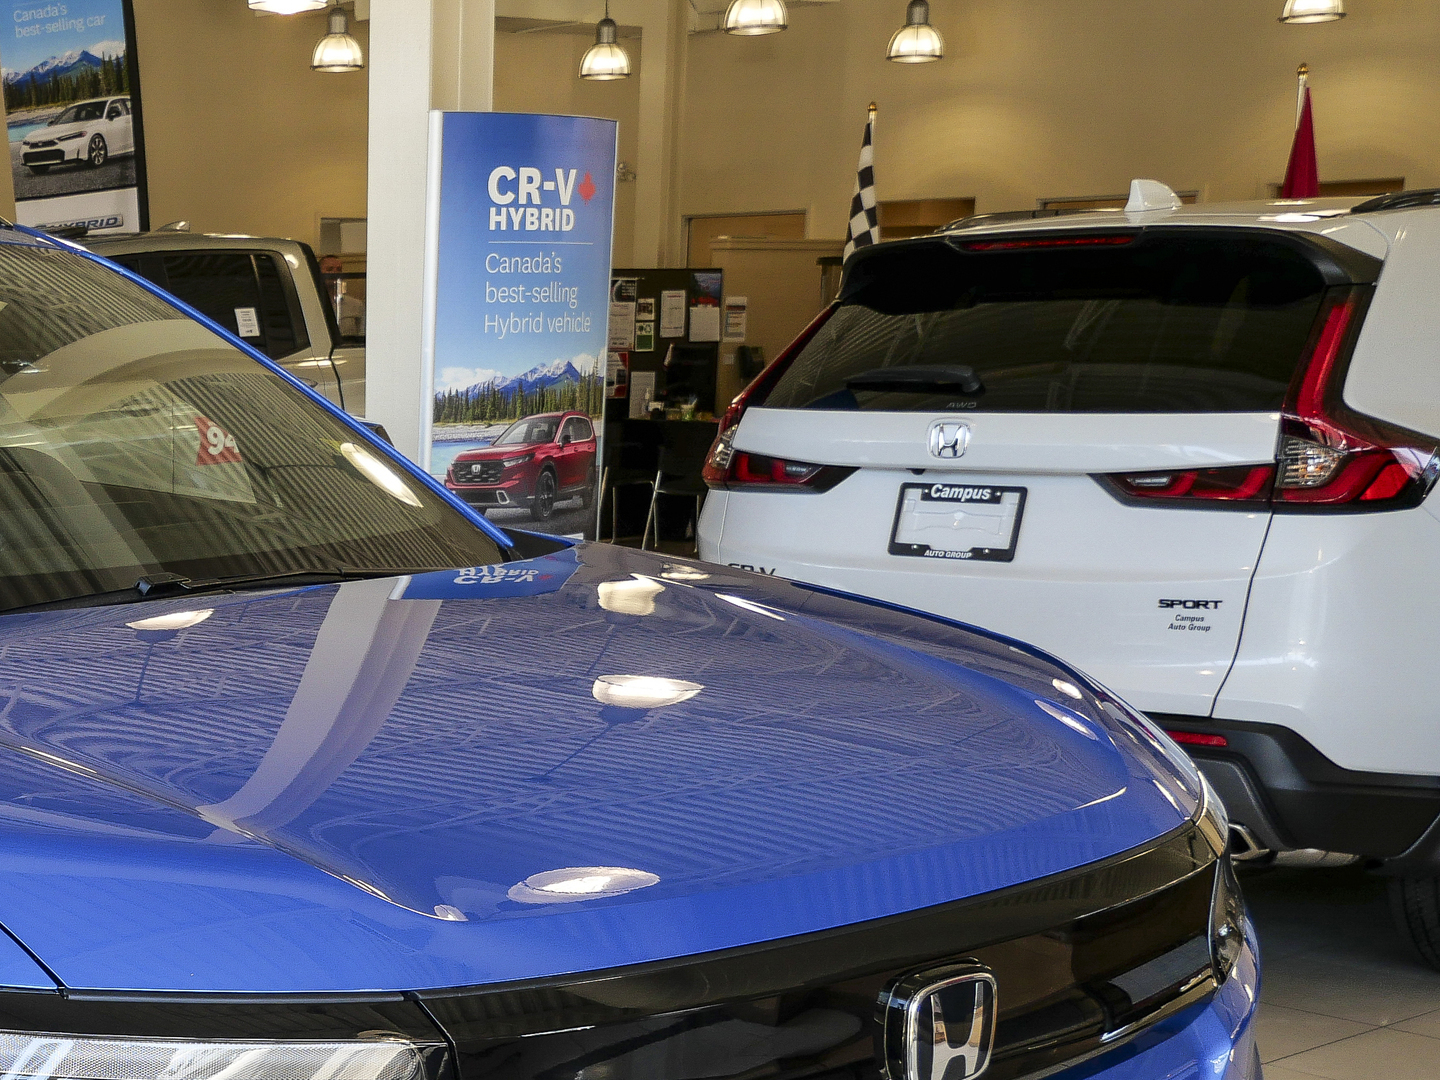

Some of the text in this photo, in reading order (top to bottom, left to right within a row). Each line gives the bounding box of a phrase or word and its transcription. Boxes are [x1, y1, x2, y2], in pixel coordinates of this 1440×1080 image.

[13, 3, 68, 23] Canada's
[15, 14, 106, 38] best-selling car
[487, 165, 578, 206] CR-V
[489, 207, 575, 232] HYBRID
[485, 251, 562, 274] Canada's
[485, 281, 578, 309] best-selling
[484, 311, 543, 340] Hybrid
[930, 484, 992, 503] Campus
[924, 550, 973, 559] AUTO GROUP
[1157, 599, 1223, 609] SPORT
[1167, 623, 1211, 632] Auto Group
[1175, 614, 1205, 622] Campus
